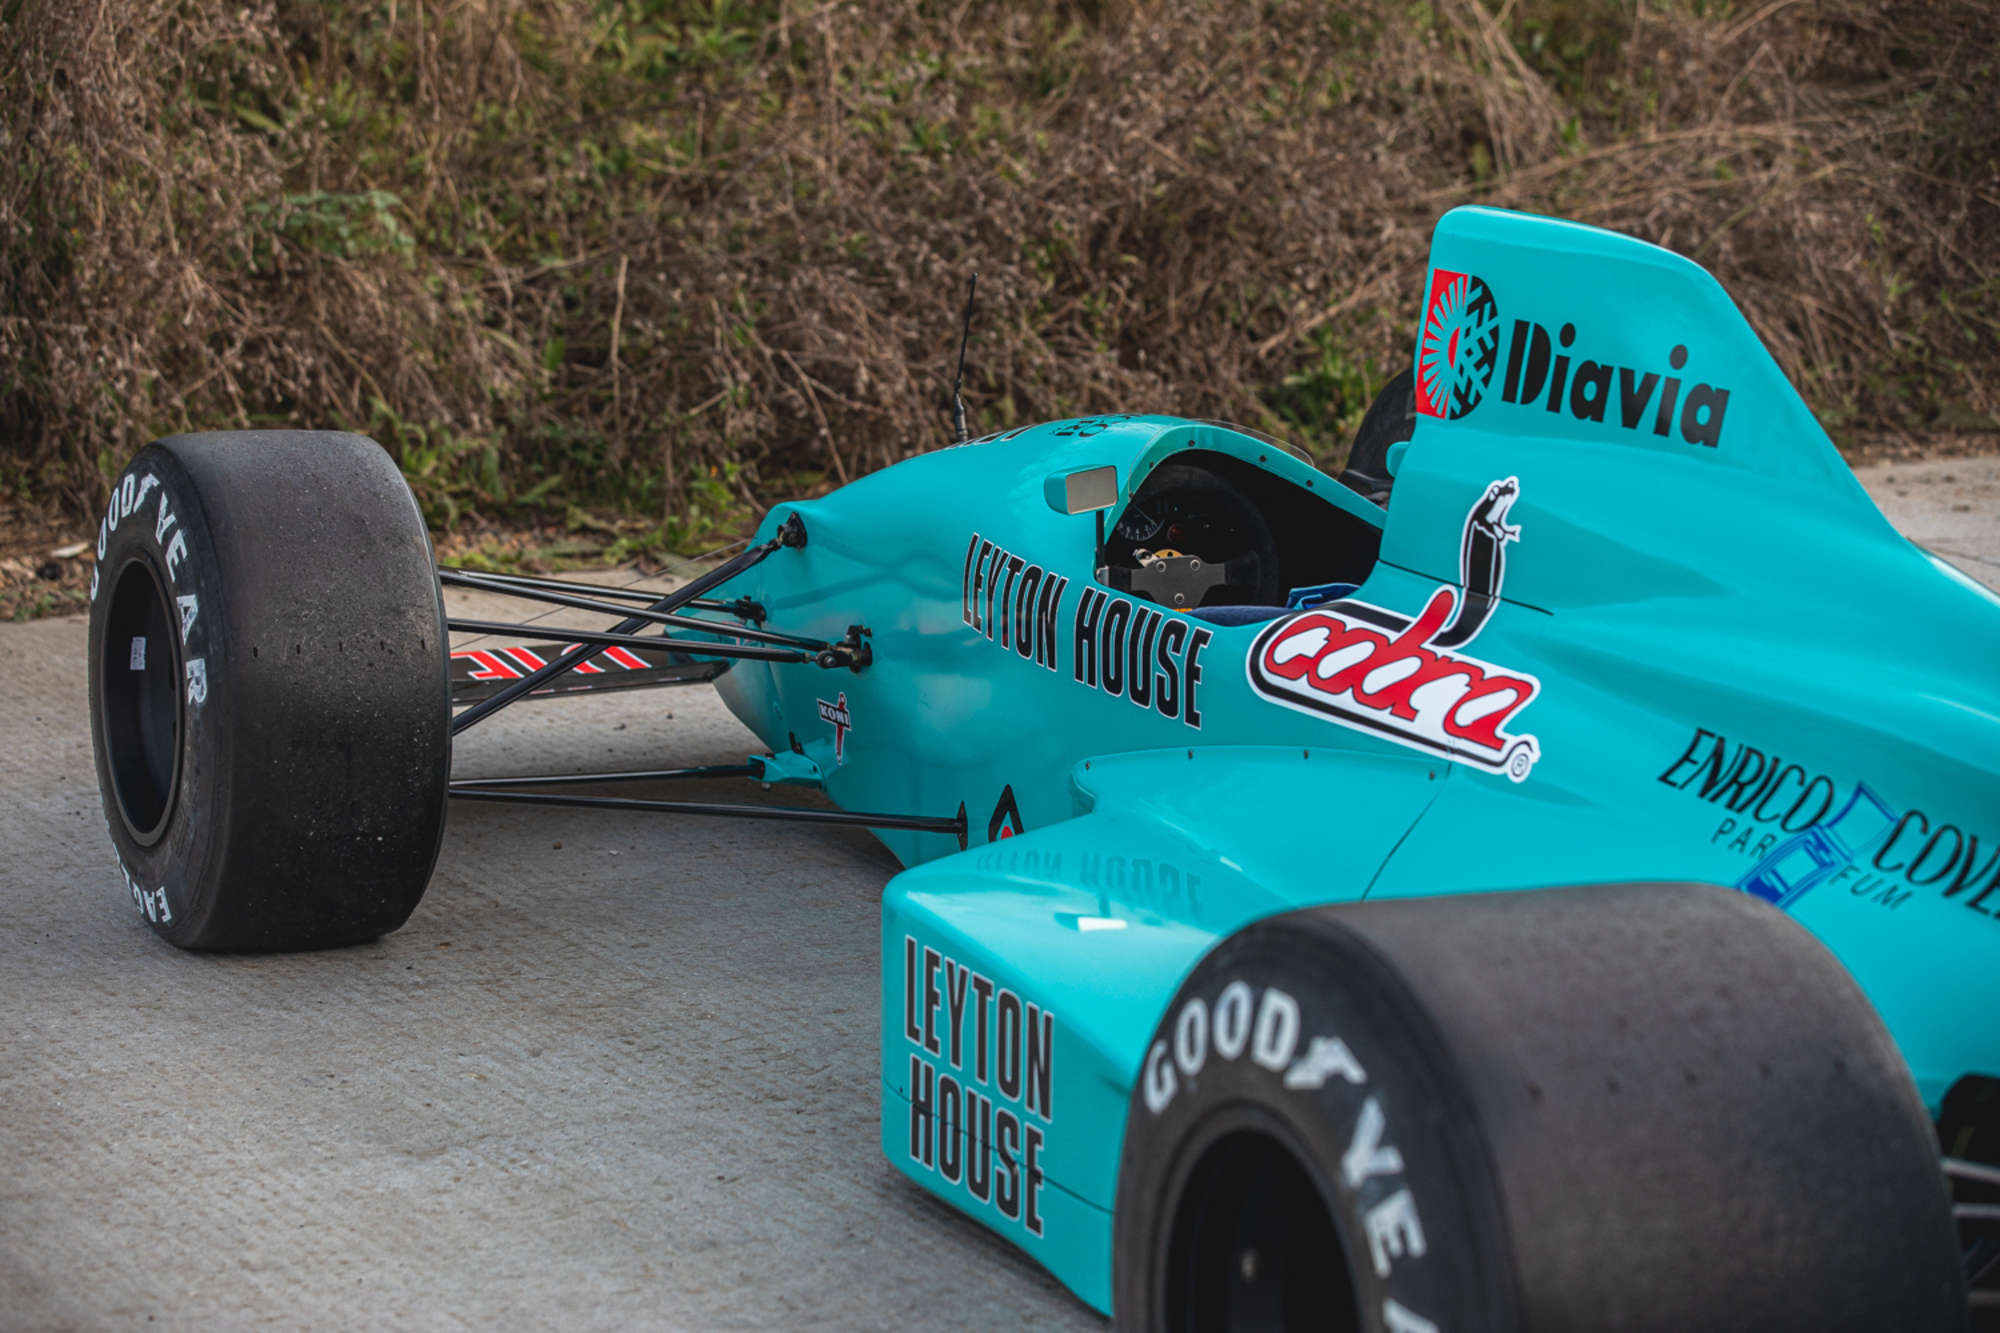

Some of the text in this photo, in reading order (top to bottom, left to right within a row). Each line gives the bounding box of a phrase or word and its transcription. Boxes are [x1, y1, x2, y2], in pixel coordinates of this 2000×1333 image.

[1502, 319, 1730, 448] Diavia
[962, 532, 1214, 731] LEYTON HOUSE
[1264, 589, 1534, 751] cobra
[819, 702, 850, 727] KONI
[1657, 727, 1835, 833] ENRICO
[1710, 817, 1913, 910] PAR FUM
[904, 933, 1054, 1124] LEYTON
[909, 1052, 1044, 1239] HOUSE
